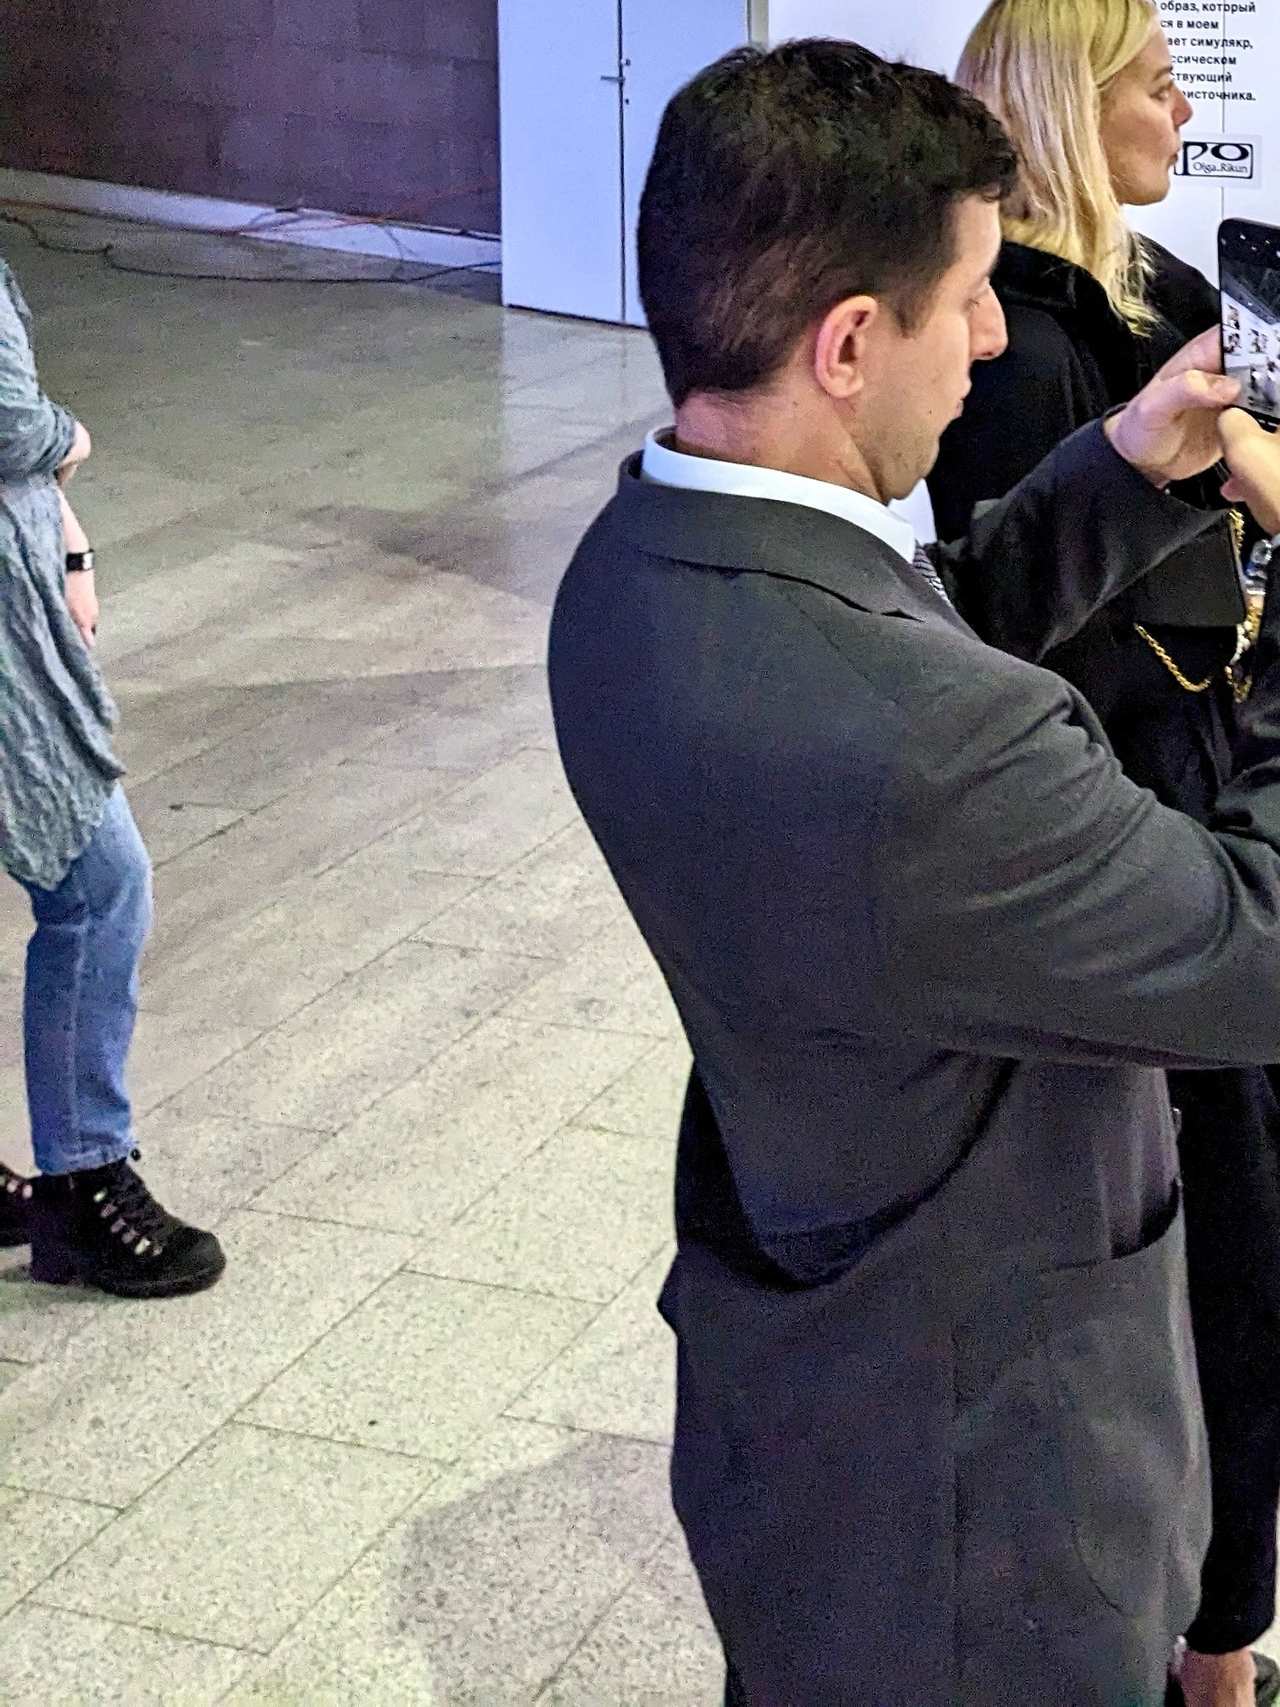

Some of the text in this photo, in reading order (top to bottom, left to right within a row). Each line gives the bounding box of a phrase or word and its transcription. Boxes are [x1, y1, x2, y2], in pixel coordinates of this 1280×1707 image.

[1160, 0, 1200, 13] образ,
[1201, 1, 1256, 14] который
[1176, 20, 1184, 29] в
[1186, 20, 1219, 30] моем
[1190, 37, 1254, 50] симулякр,
